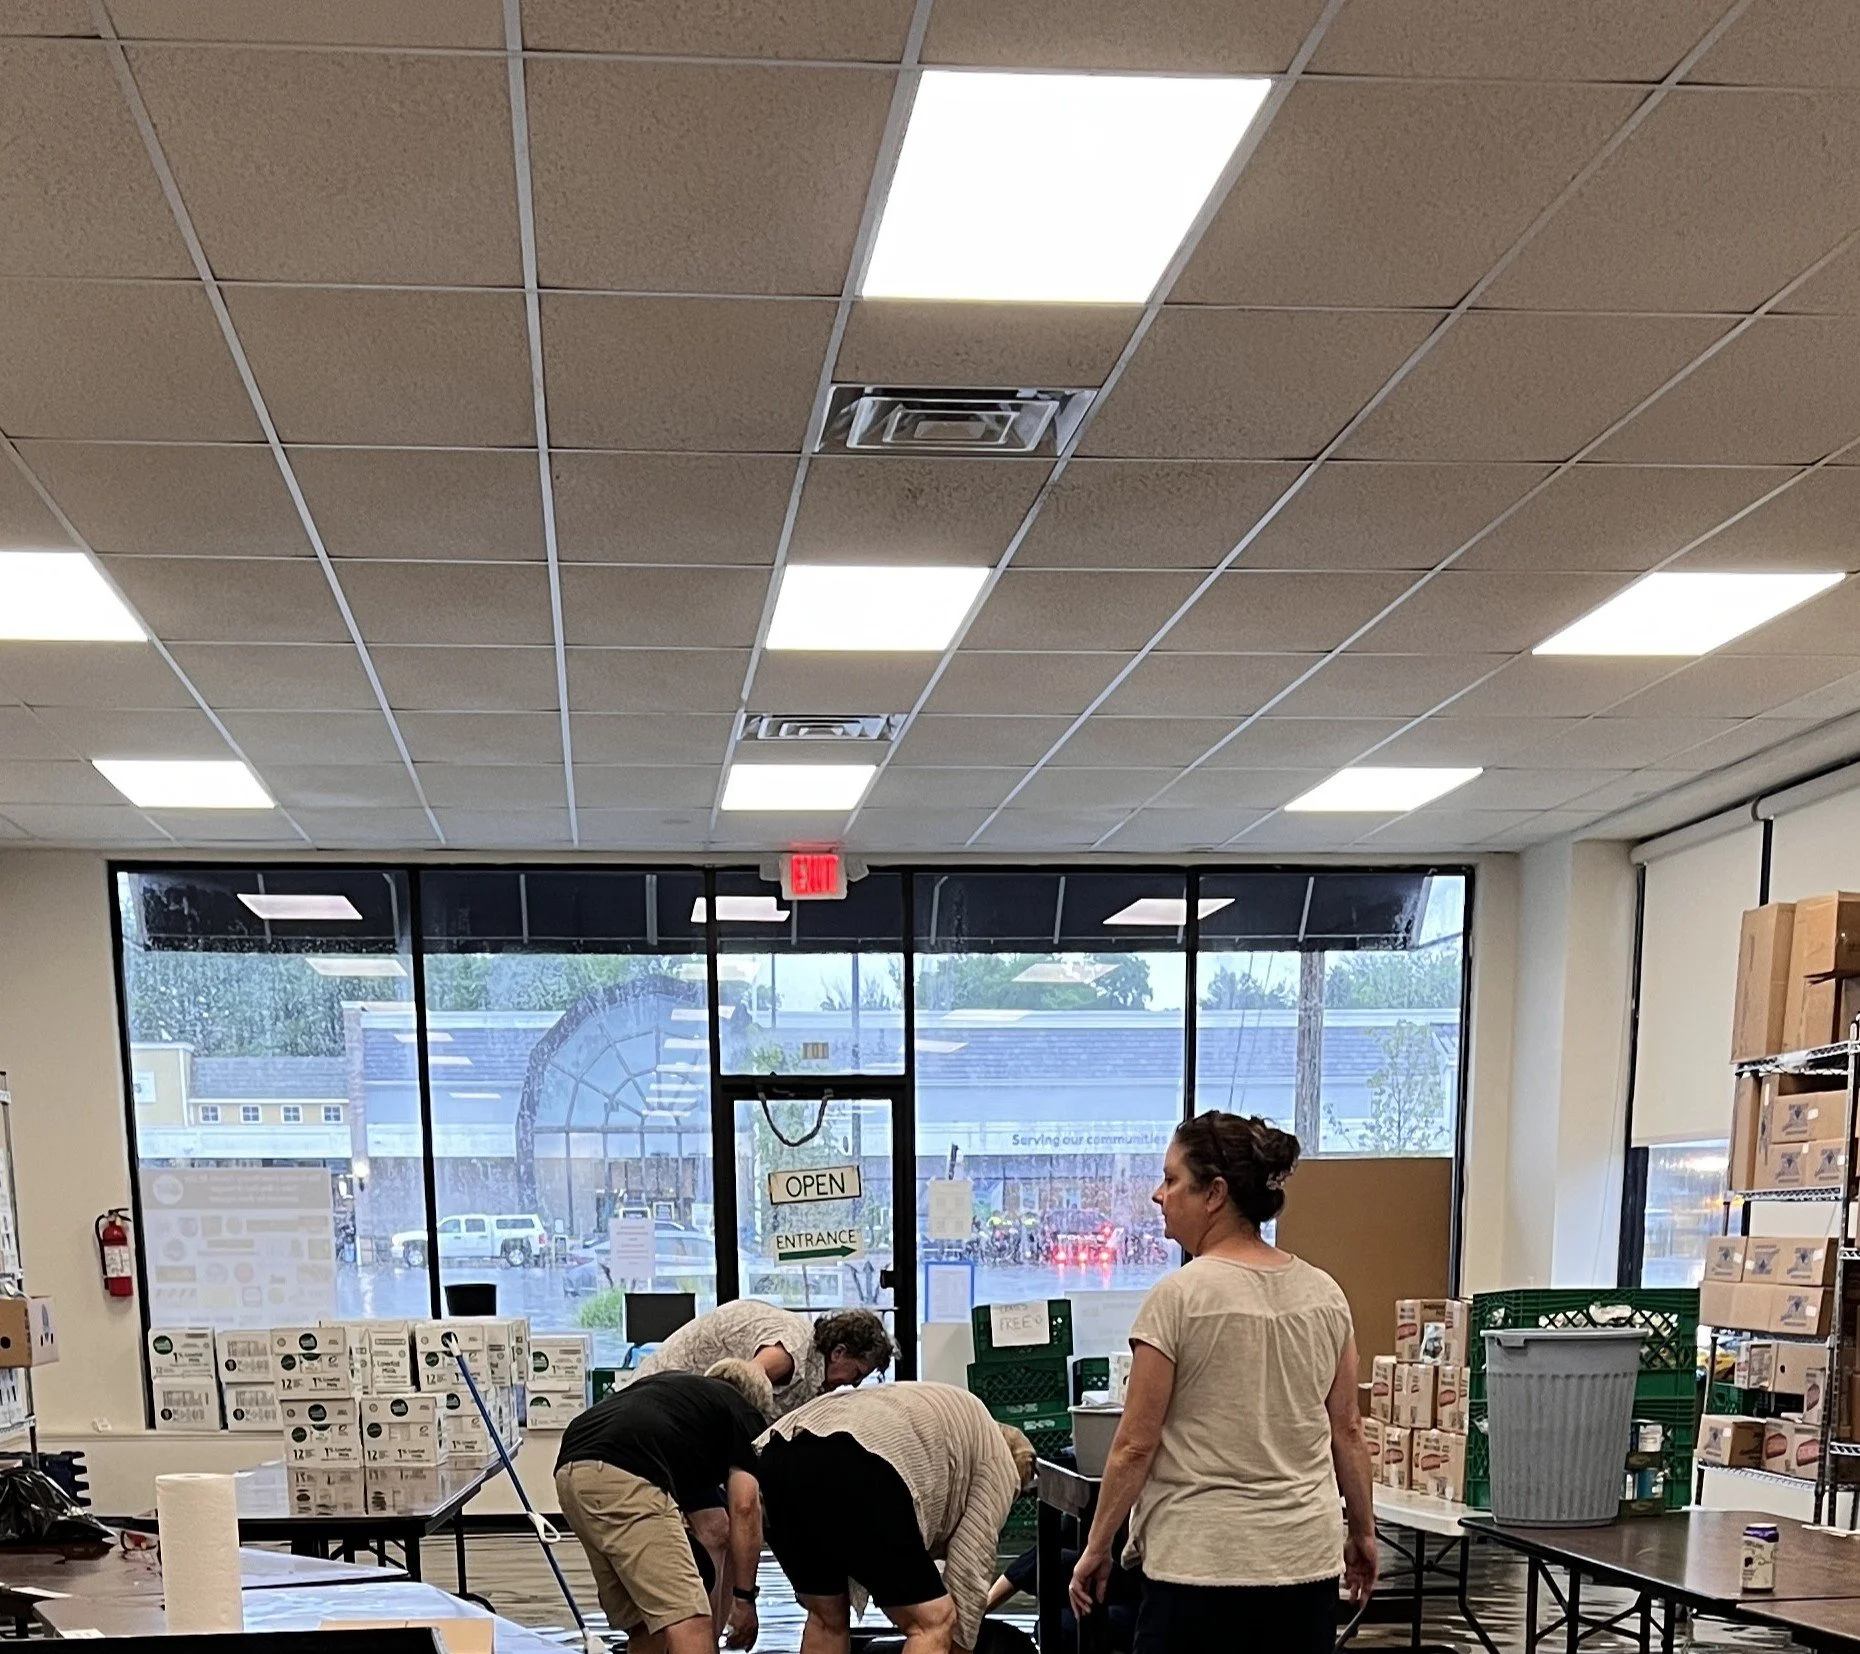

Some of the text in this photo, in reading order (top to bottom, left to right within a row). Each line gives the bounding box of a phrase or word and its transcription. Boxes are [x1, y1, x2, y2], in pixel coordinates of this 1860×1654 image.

[791, 855, 838, 893] EXIT
[1012, 1134, 1167, 1147] Serving our communities
[785, 1172, 846, 1198] OPEN
[776, 1229, 857, 1249] ENTRANCE
[1000, 1315, 1032, 1331] FREE
[377, 1360, 401, 1368] Lowfat
[281, 1378, 293, 1391] 12
[426, 1373, 437, 1386] 12
[293, 1448, 305, 1461] 12
[367, 1450, 378, 1462] 12
